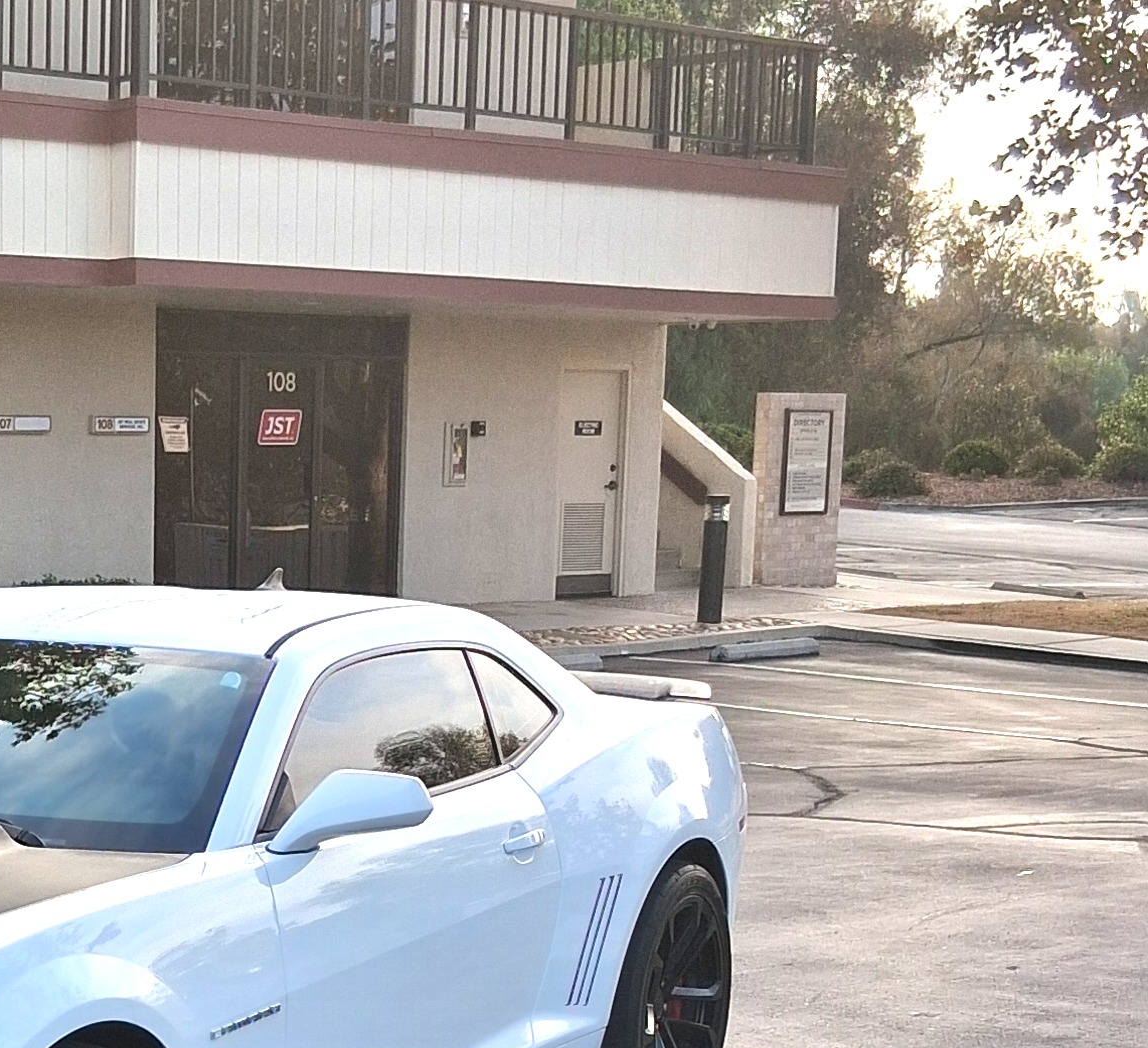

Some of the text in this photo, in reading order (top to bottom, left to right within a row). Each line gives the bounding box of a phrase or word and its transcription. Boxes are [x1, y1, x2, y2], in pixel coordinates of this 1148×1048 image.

[266, 371, 297, 393] 108
[97, 419, 114, 430] 108
[264, 416, 296, 436] JST
